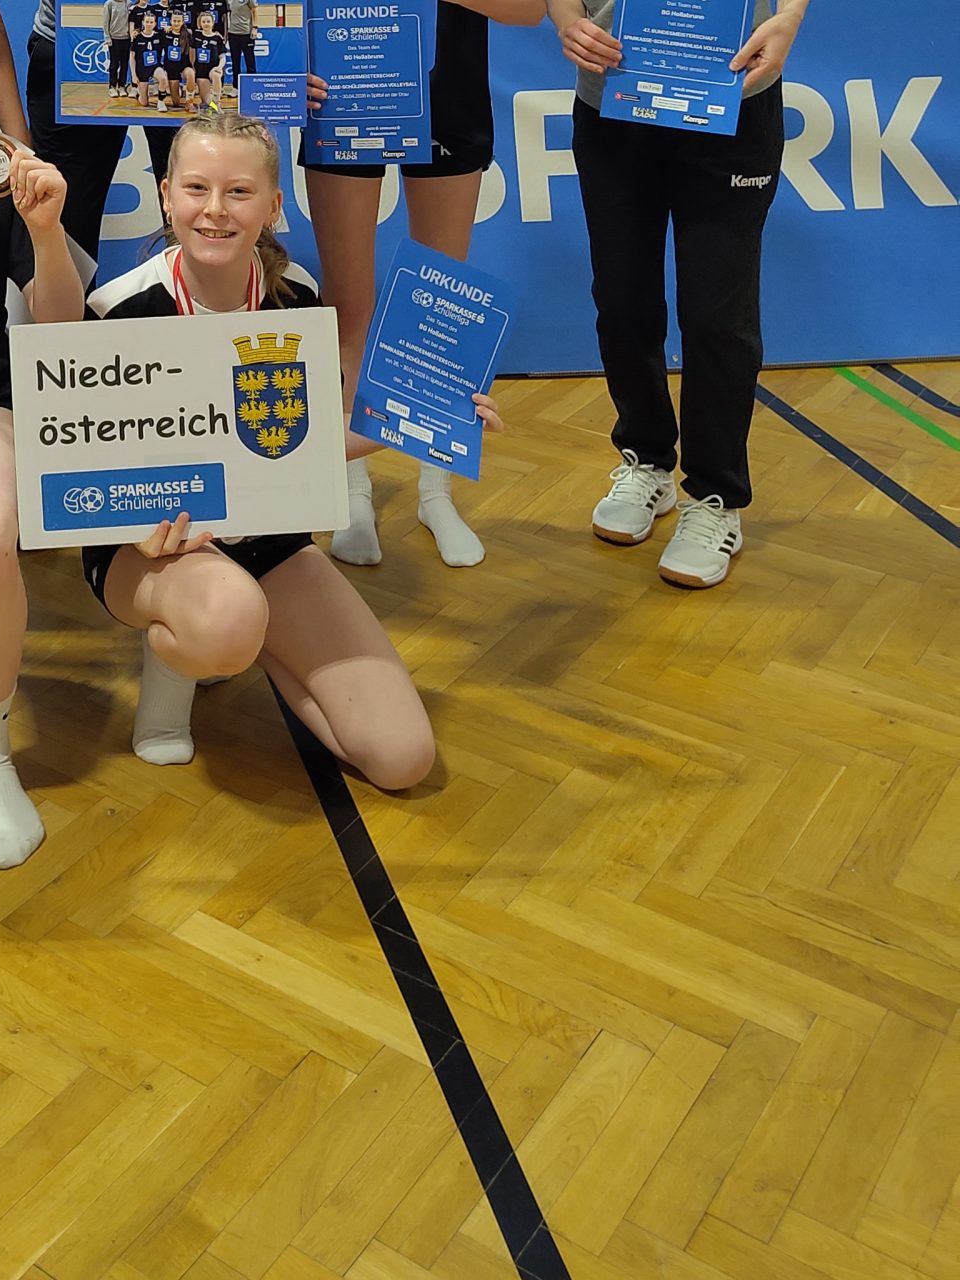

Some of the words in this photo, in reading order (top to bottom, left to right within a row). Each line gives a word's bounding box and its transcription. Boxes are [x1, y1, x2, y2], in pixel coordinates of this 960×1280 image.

[326, 4, 397, 19] URKUNDE
[350, 26, 391, 34] SPARKASSE
[351, 33, 387, 42] Schülerliga
[420, 265, 494, 308] URKUNDE
[433, 304, 470, 326] Schülerliga
[435, 297, 477, 321] SPARKASSE
[36, 354, 183, 392] Nieder-
[39, 403, 230, 446] österreich
[108, 481, 189, 499] SPARKASSE
[109, 496, 182, 512] Schülerliga
